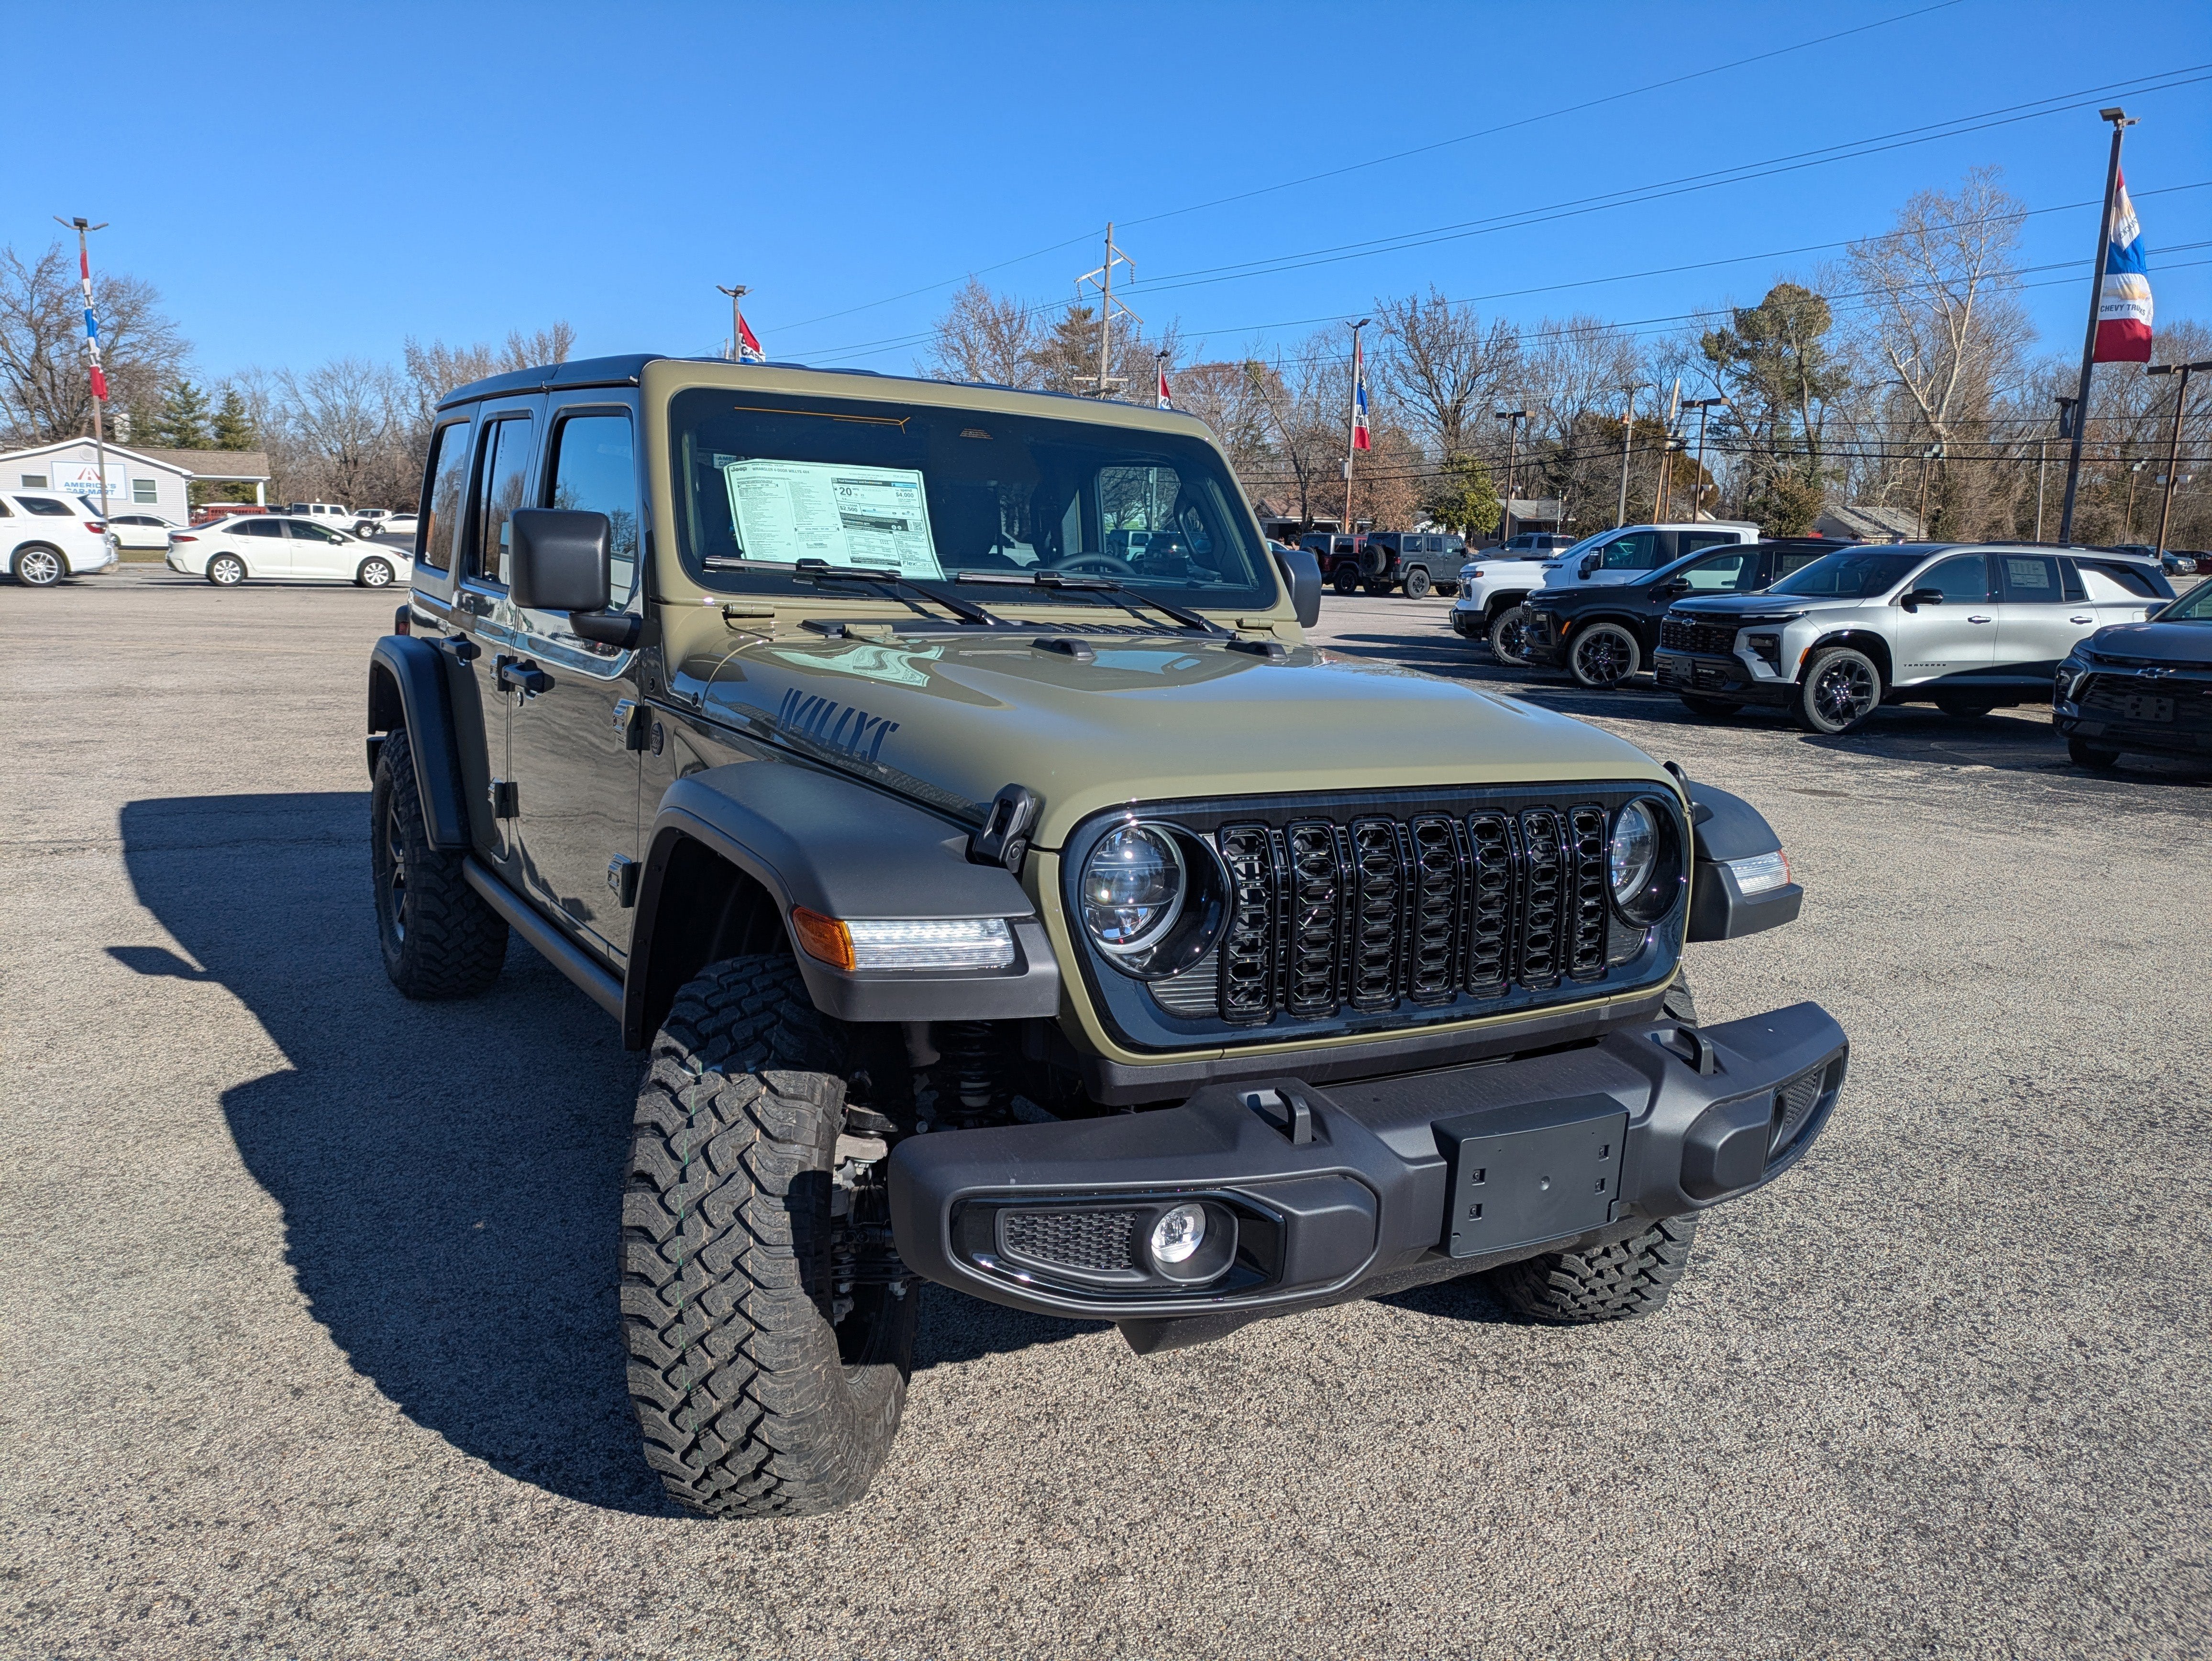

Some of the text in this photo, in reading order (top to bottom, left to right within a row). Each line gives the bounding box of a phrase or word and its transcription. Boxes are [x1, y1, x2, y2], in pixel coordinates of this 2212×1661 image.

[2100, 304, 2146, 316] CHEVY TRUKS
[839, 487, 852, 496] 20
[776, 687, 900, 764] WILLYS
